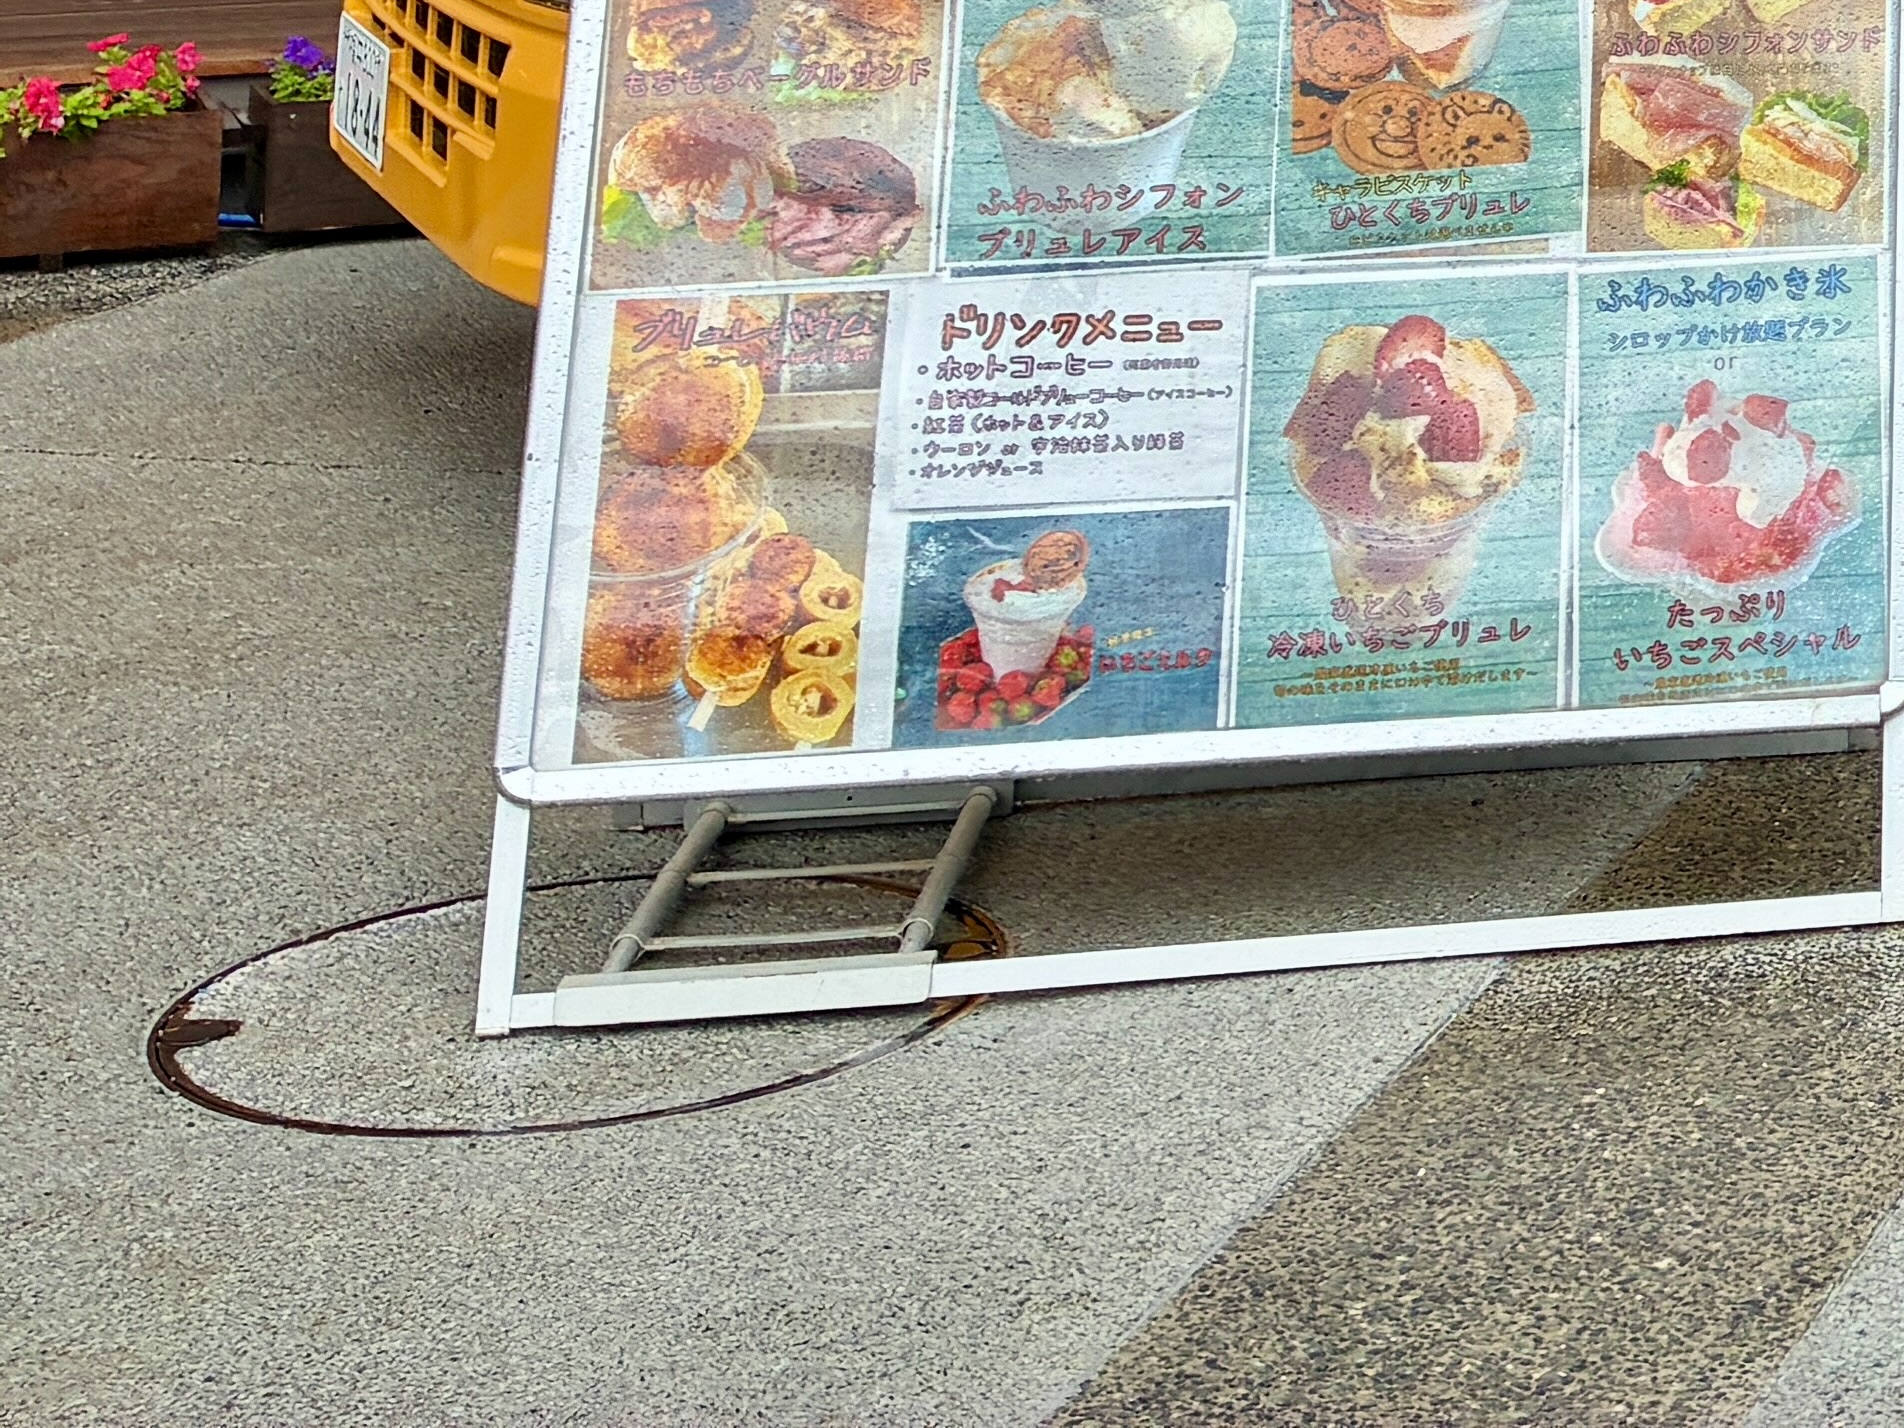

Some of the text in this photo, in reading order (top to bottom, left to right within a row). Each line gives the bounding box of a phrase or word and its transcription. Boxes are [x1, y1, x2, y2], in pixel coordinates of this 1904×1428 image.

[1610, 25, 1886, 57] ふわふわシフォンサンド
[622, 55, 933, 99] もちもちベーグルサンド
[976, 181, 1245, 217] ふわふわシフォン
[1311, 168, 1474, 202] キャラビスケット
[1328, 190, 1532, 231] ひとくちブリュレ
[978, 223, 1209, 259] ブリュレアイス
[1596, 263, 1853, 314] ふわふわかき氷
[940, 302, 1225, 351] ドリンクメニュー
[1606, 315, 1853, 353] シロップかけ放題プラン
[1713, 354, 1738, 371] or
[1329, 585, 1448, 623] ひとくち
[1666, 589, 1787, 629] たっぷり
[1266, 616, 1533, 661] 冷凍いちごブリュレ
[1613, 623, 1863, 671] いちごスペシャル
